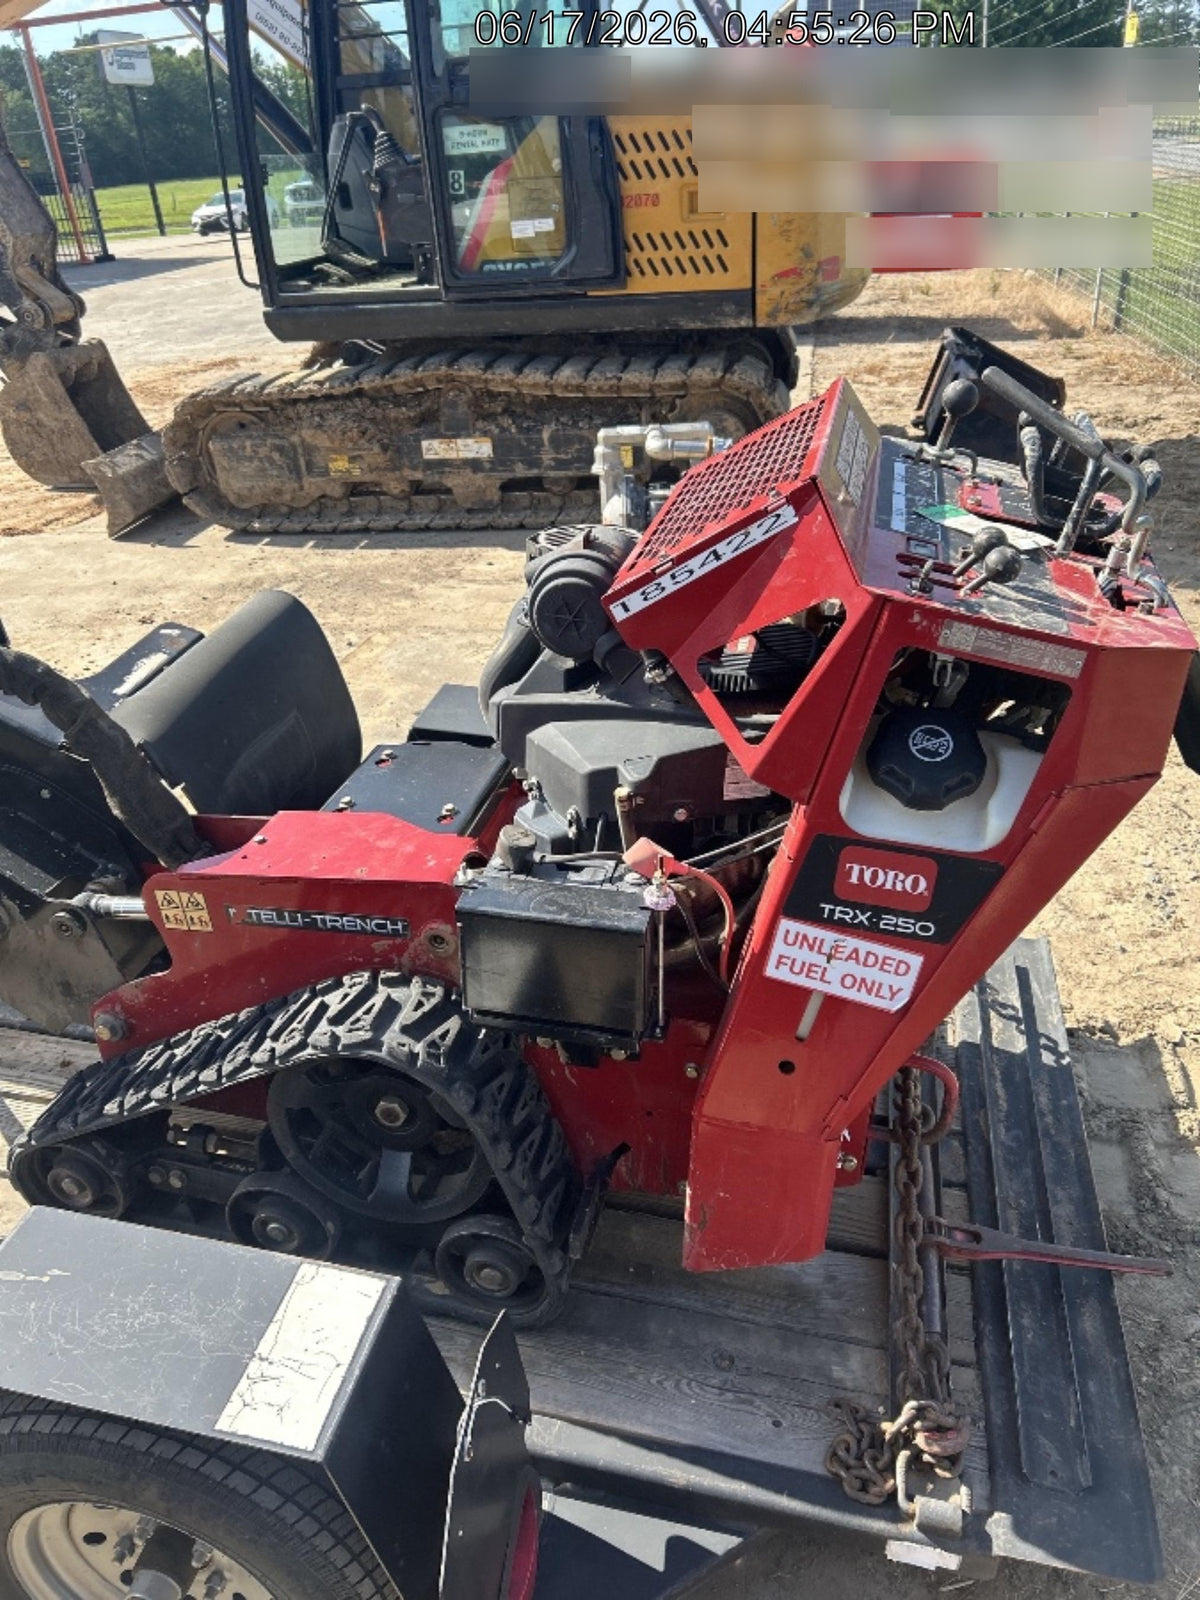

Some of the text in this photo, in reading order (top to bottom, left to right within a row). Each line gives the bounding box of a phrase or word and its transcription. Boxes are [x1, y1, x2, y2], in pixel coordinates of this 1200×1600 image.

[450, 172, 463, 192] 8
[612, 513, 789, 613] 185422
[844, 863, 928, 895] TORO
[783, 929, 912, 977] UNLEADED
[774, 954, 904, 1002] FUEL ONLY
